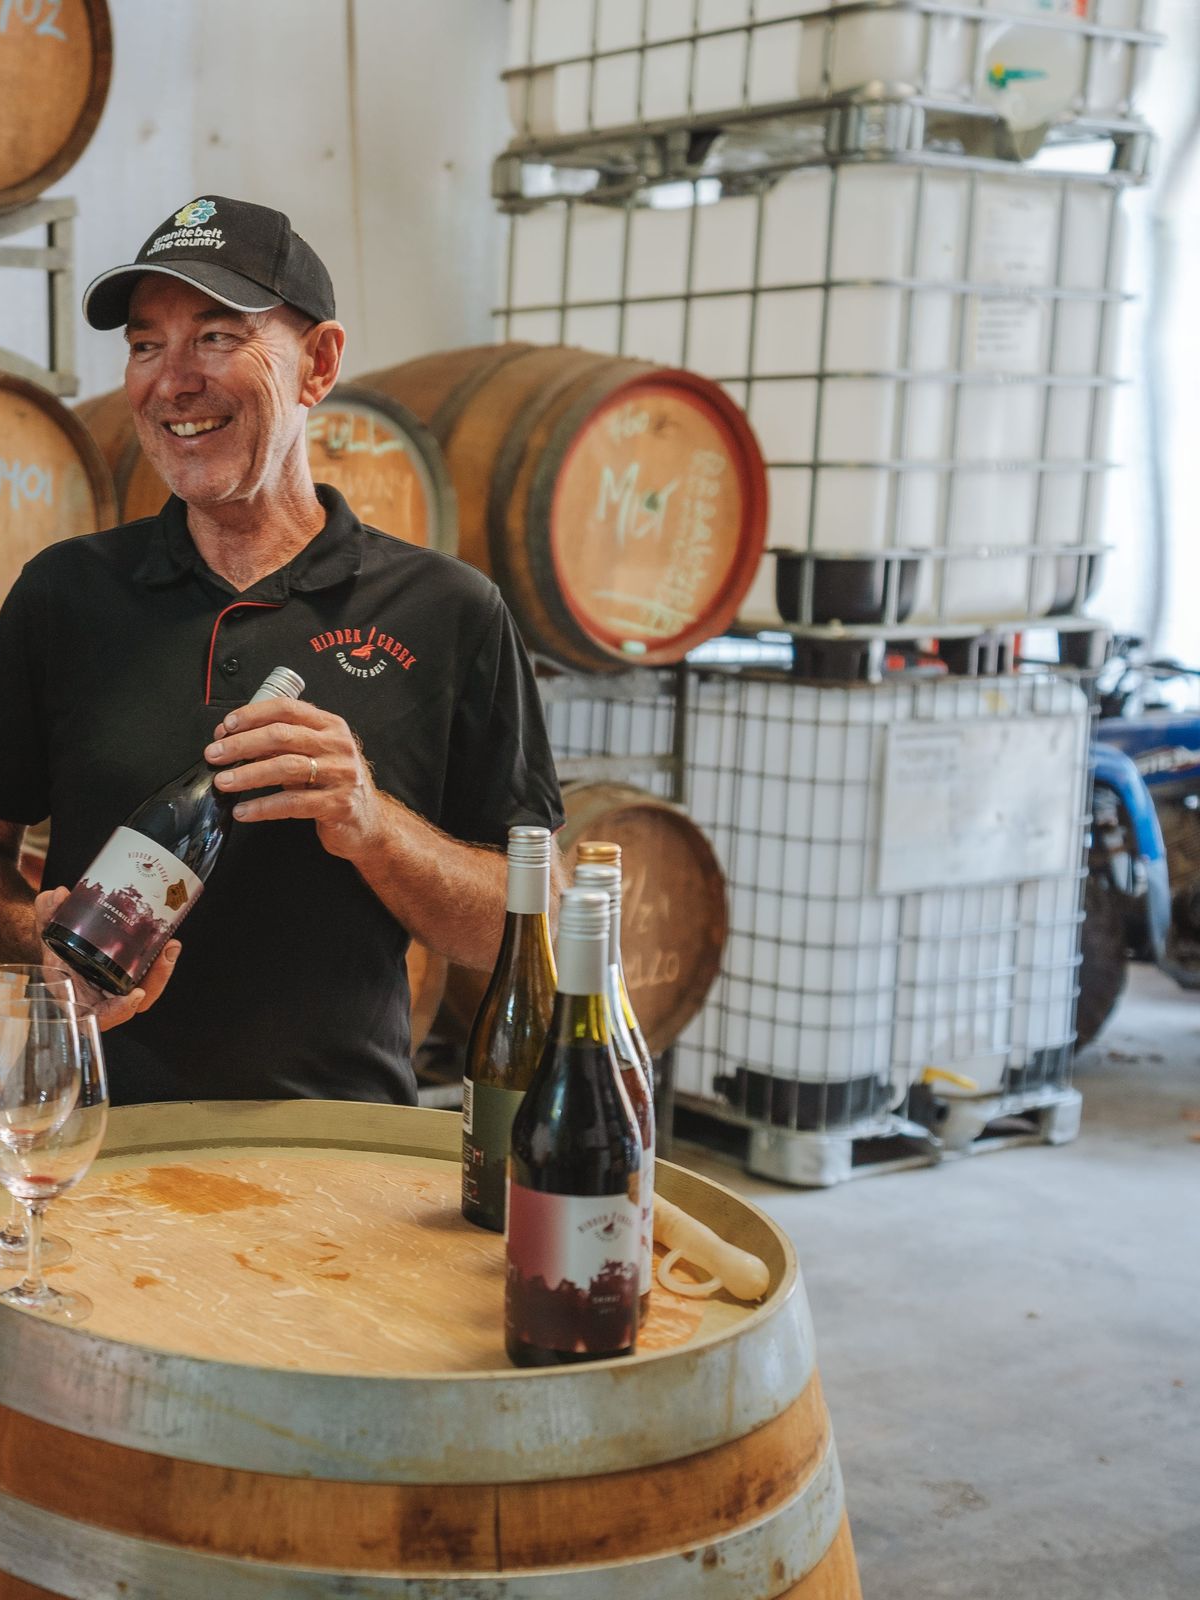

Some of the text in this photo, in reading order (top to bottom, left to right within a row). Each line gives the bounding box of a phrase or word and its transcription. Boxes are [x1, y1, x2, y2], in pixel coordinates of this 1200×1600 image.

[174, 237, 226, 250] country
[309, 628, 417, 671] HIDDEN CREEK
[336, 651, 388, 678] GRANITE BELT
